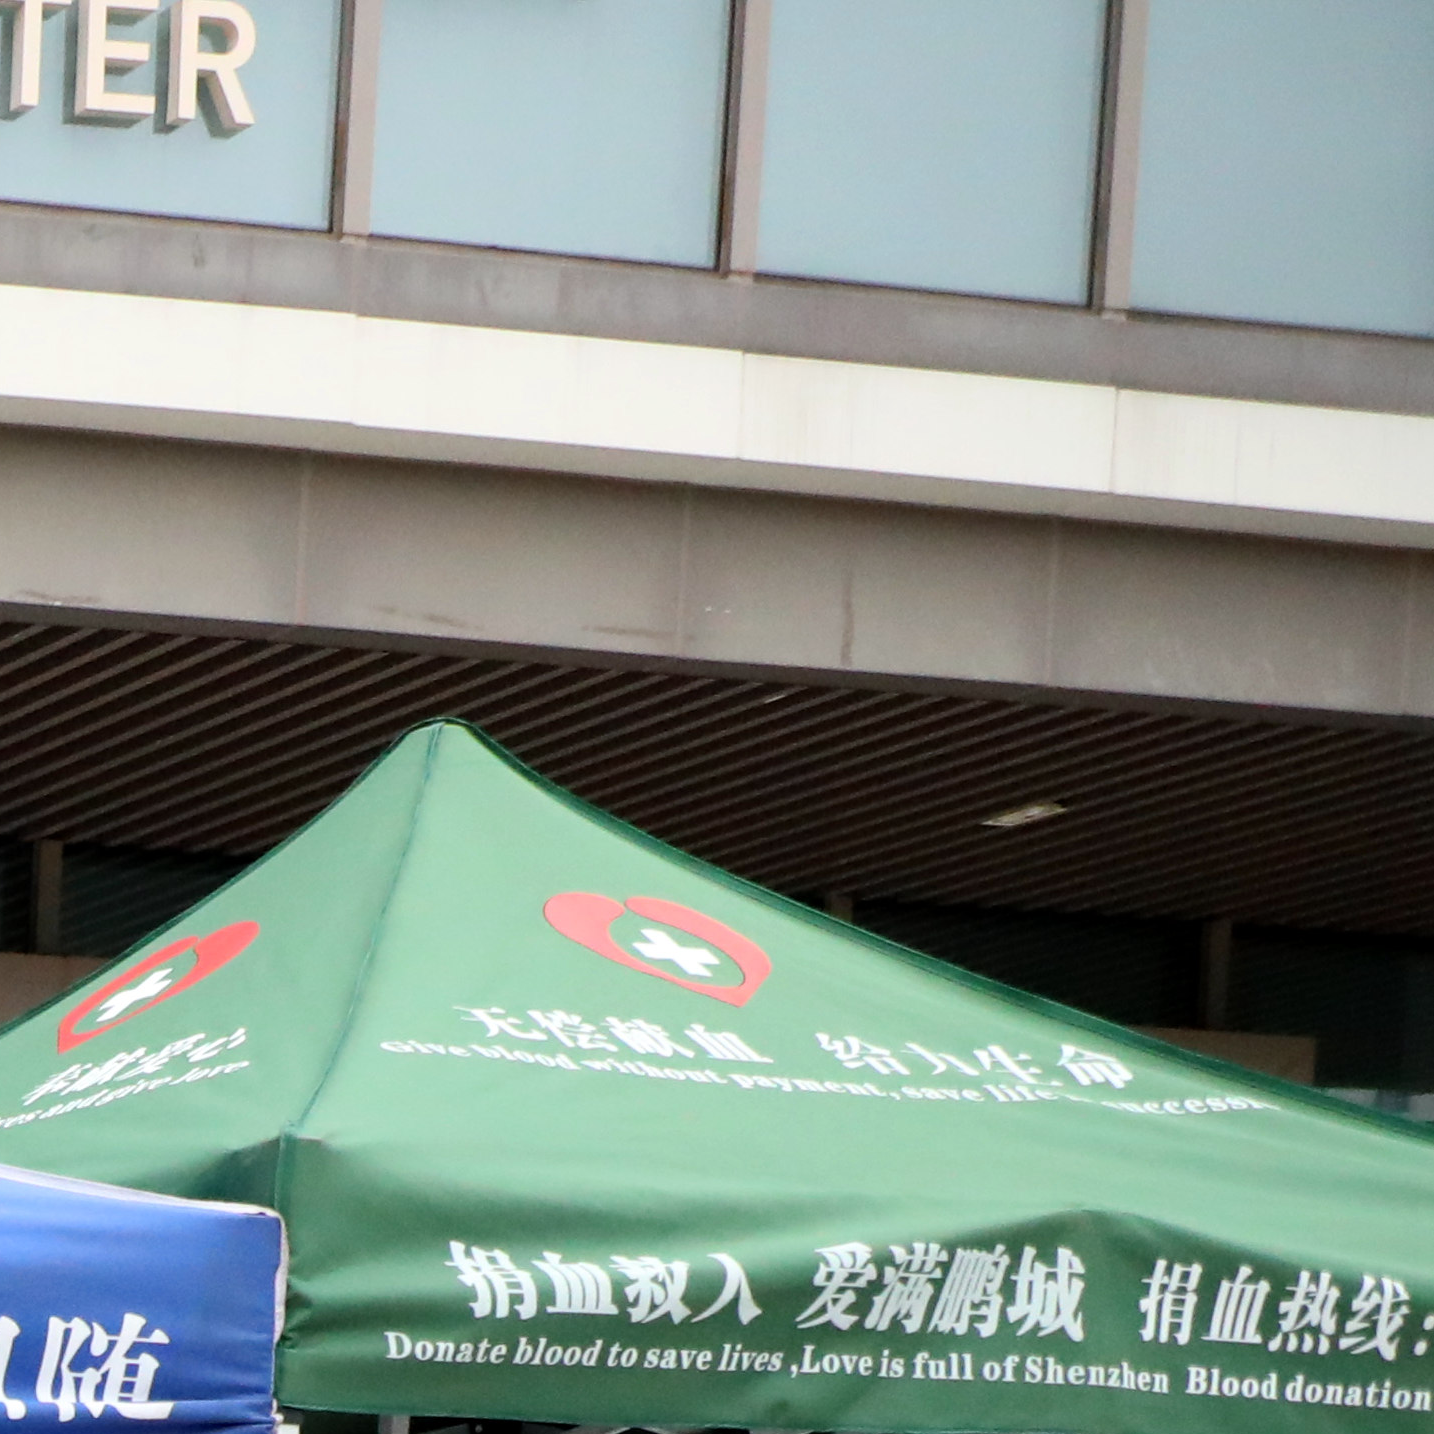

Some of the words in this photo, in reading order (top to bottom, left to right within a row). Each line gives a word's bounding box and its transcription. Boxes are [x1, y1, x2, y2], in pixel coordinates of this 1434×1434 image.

[379, 1039, 472, 1058] Give
[479, 1043, 581, 1071] blood
[581, 1059, 728, 1086] without
[453, 1005, 774, 1064] 无偿献血
[815, 1032, 1134, 1089] 给力生命
[444, 1240, 763, 1326] 捐血救人
[795, 1241, 1086, 1342] 爱满鹏城
[383, 1330, 507, 1365] Donate
[513, 1336, 598, 1368] blood
[607, 1340, 638, 1368] to
[644, 1346, 712, 1371] save
[717, 1343, 784, 1372] lives
[878, 1348, 905, 1379] is
[912, 1352, 974, 1381] full
[982, 1354, 1019, 1383] of
[1024, 1355, 1169, 1395] Shenzhen
[1185, 1365, 1278, 1401] Blood
[1285, 1374, 1433, 1412] donation
